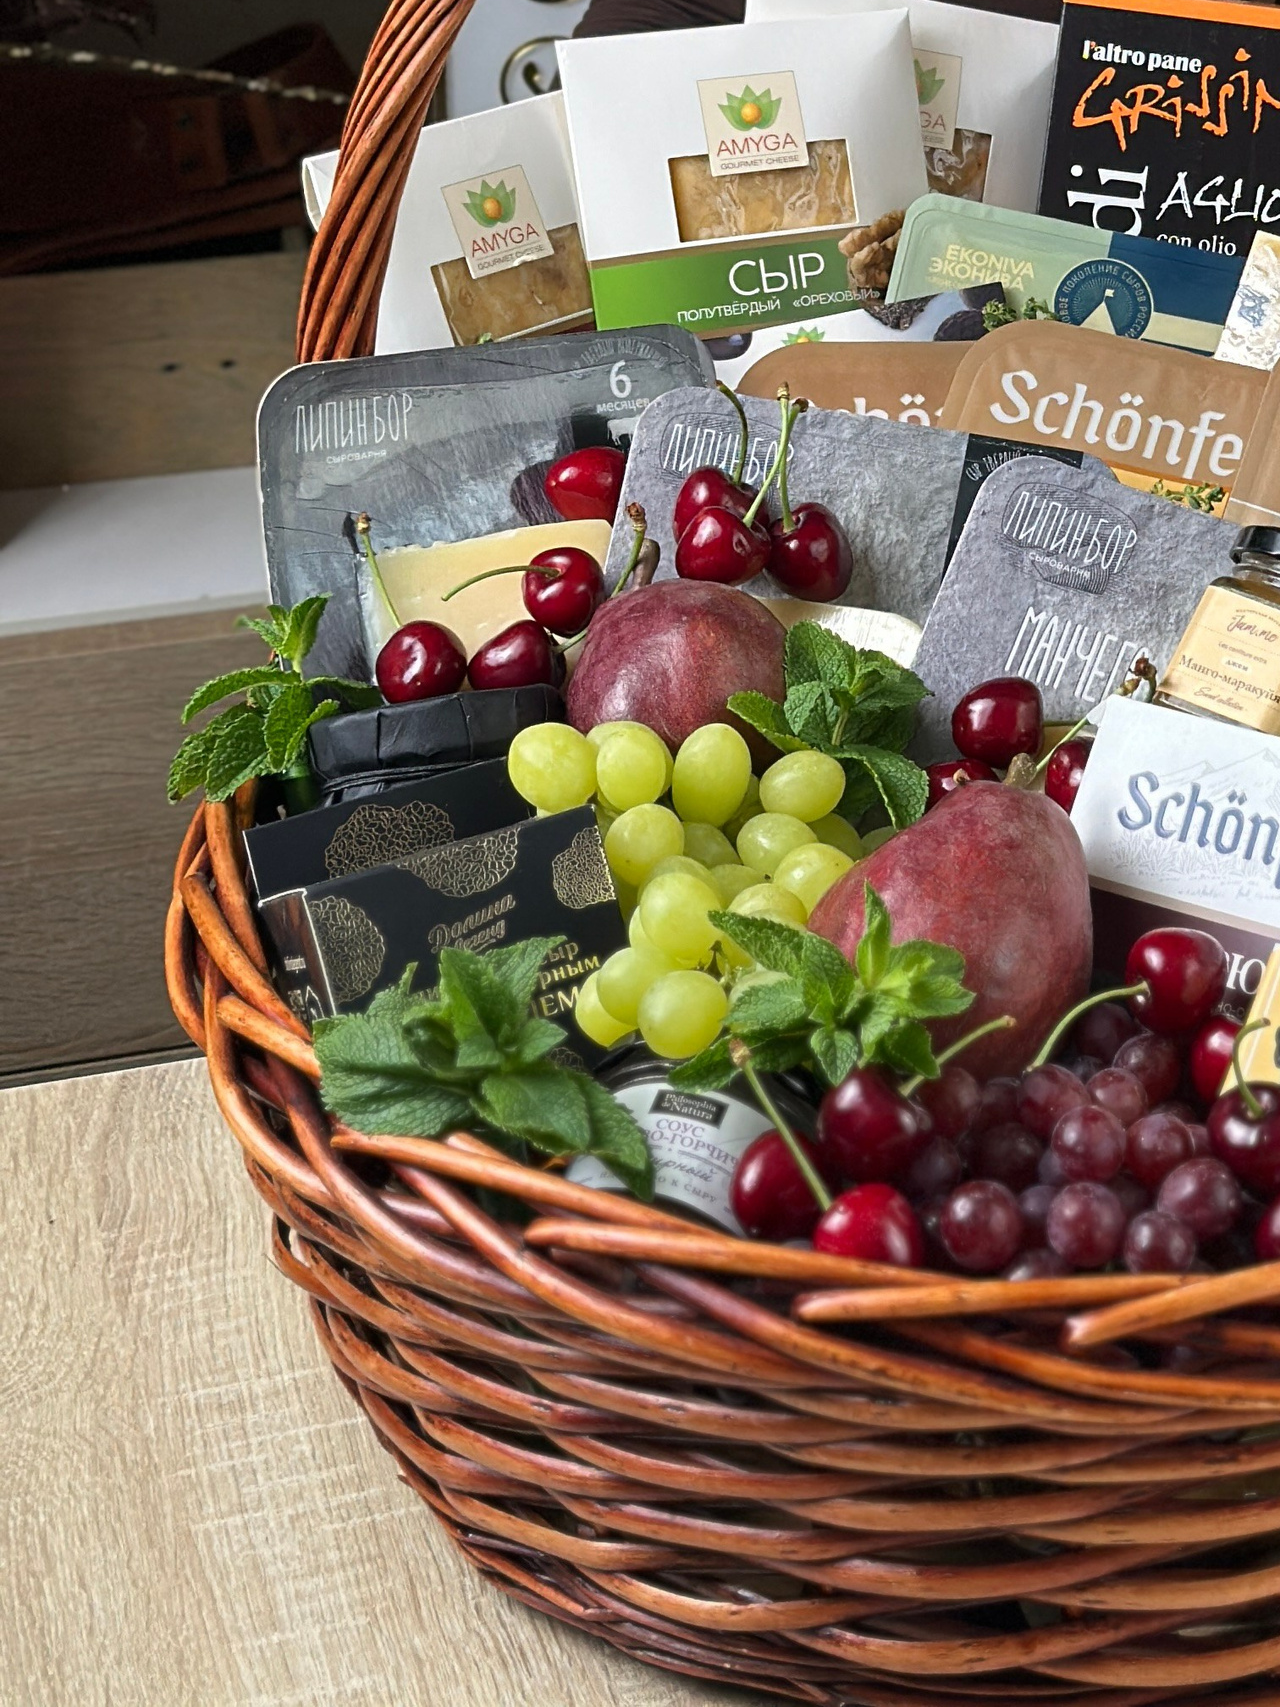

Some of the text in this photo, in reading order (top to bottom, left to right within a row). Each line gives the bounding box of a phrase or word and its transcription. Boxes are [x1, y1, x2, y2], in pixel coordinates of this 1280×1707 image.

[1147, 51, 1203, 73] pane
[716, 133, 799, 157] AMYGA
[720, 154, 800, 171] GOURMET CHEESE
[471, 223, 540, 258] AMYGA
[1198, 234, 1237, 256] olio
[728, 251, 825, 296] СЫР
[928, 256, 1026, 293] ЭКОНИВА
[945, 243, 1035, 280] EKONIVA
[1063, 264, 1120, 294] ПОКОЛЕНИЕ
[1121, 268, 1148, 304] СЫРОВ
[677, 296, 781, 323] ПОЛУТВЁРДЫЙ
[1121, 304, 1149, 340] РОССИ
[609, 359, 632, 399] 6
[989, 368, 1244, 480] Schönfe
[1028, 552, 1092, 580] СЫРОВАРНЯ
[427, 893, 517, 954] Долина
[540, 941, 579, 965] ыр
[670, 1101, 713, 1120] Natura
[655, 1118, 706, 1138] СОУС
